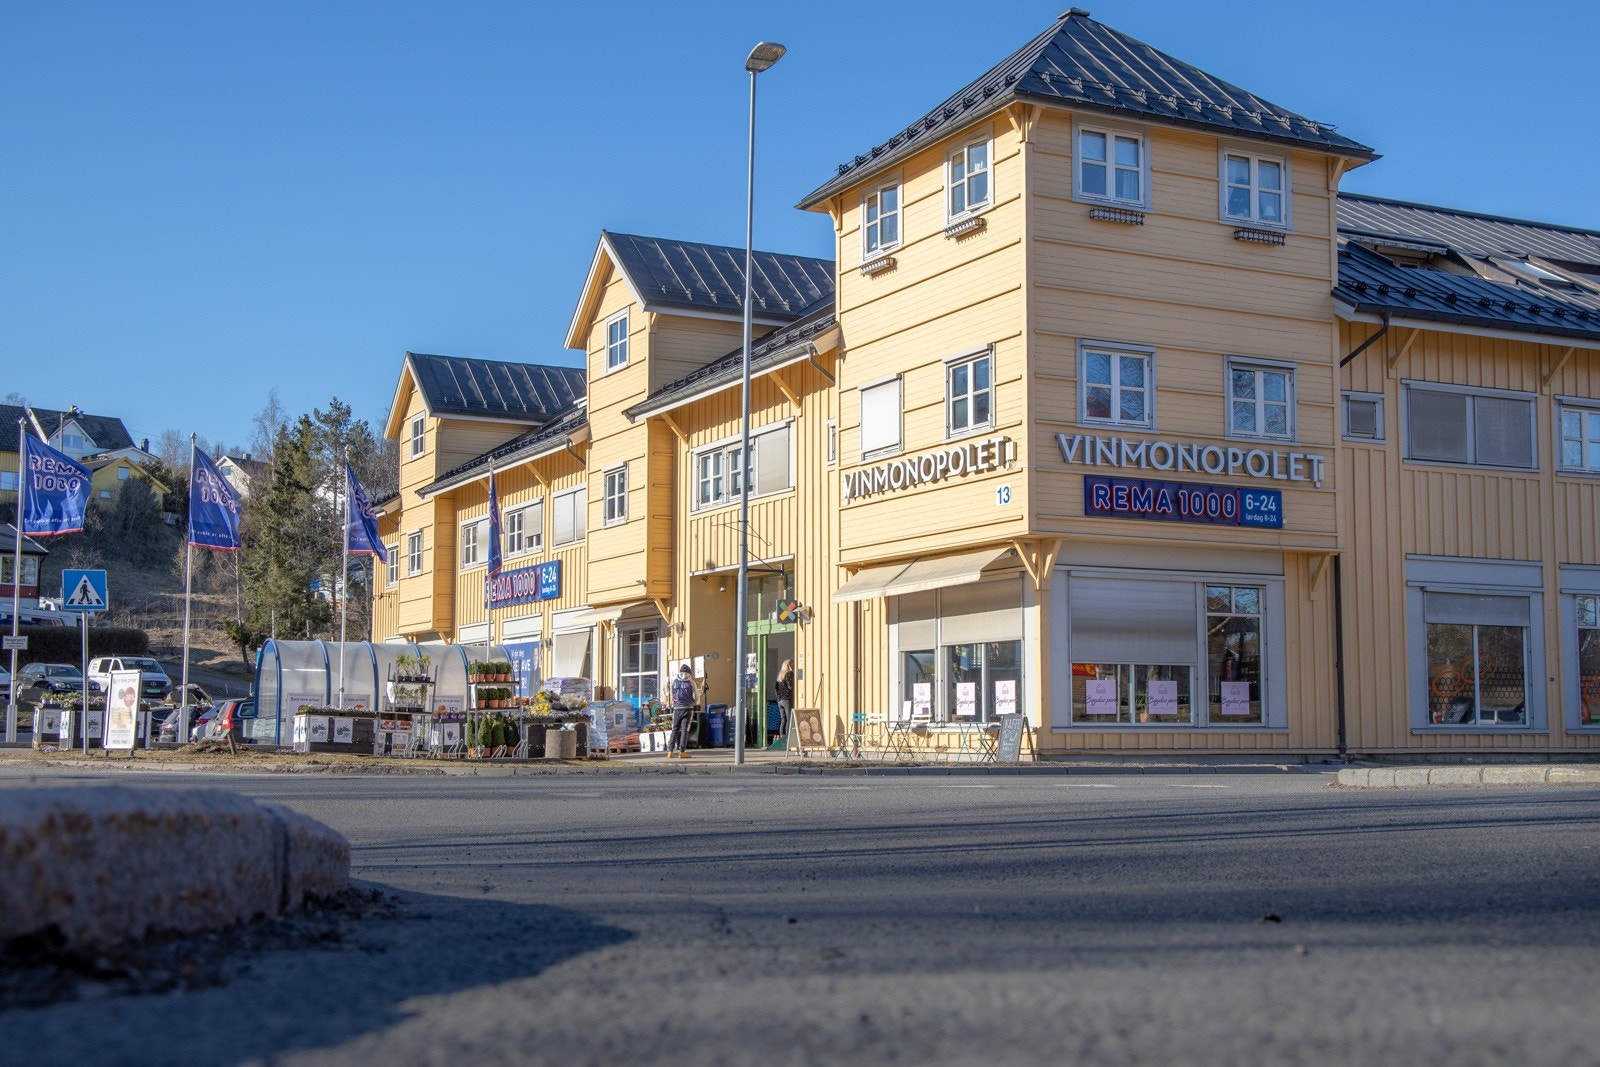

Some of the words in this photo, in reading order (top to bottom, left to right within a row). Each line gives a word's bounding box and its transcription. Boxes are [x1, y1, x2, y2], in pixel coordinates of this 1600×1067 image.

[1056, 433, 1324, 483] VINMONOPOLET
[844, 436, 1009, 502] VINMONOPOLET
[34, 474, 81, 492] 1000
[997, 486, 1011, 505] 13
[1093, 484, 1173, 513] REMA
[1178, 490, 1236, 518] 1000
[1245, 494, 1276, 512] 6-24
[1245, 513, 1263, 522] lørdag
[1264, 514, 1277, 522] 8-24
[512, 571, 536, 598] 1000
[542, 566, 557, 584] 6-24
